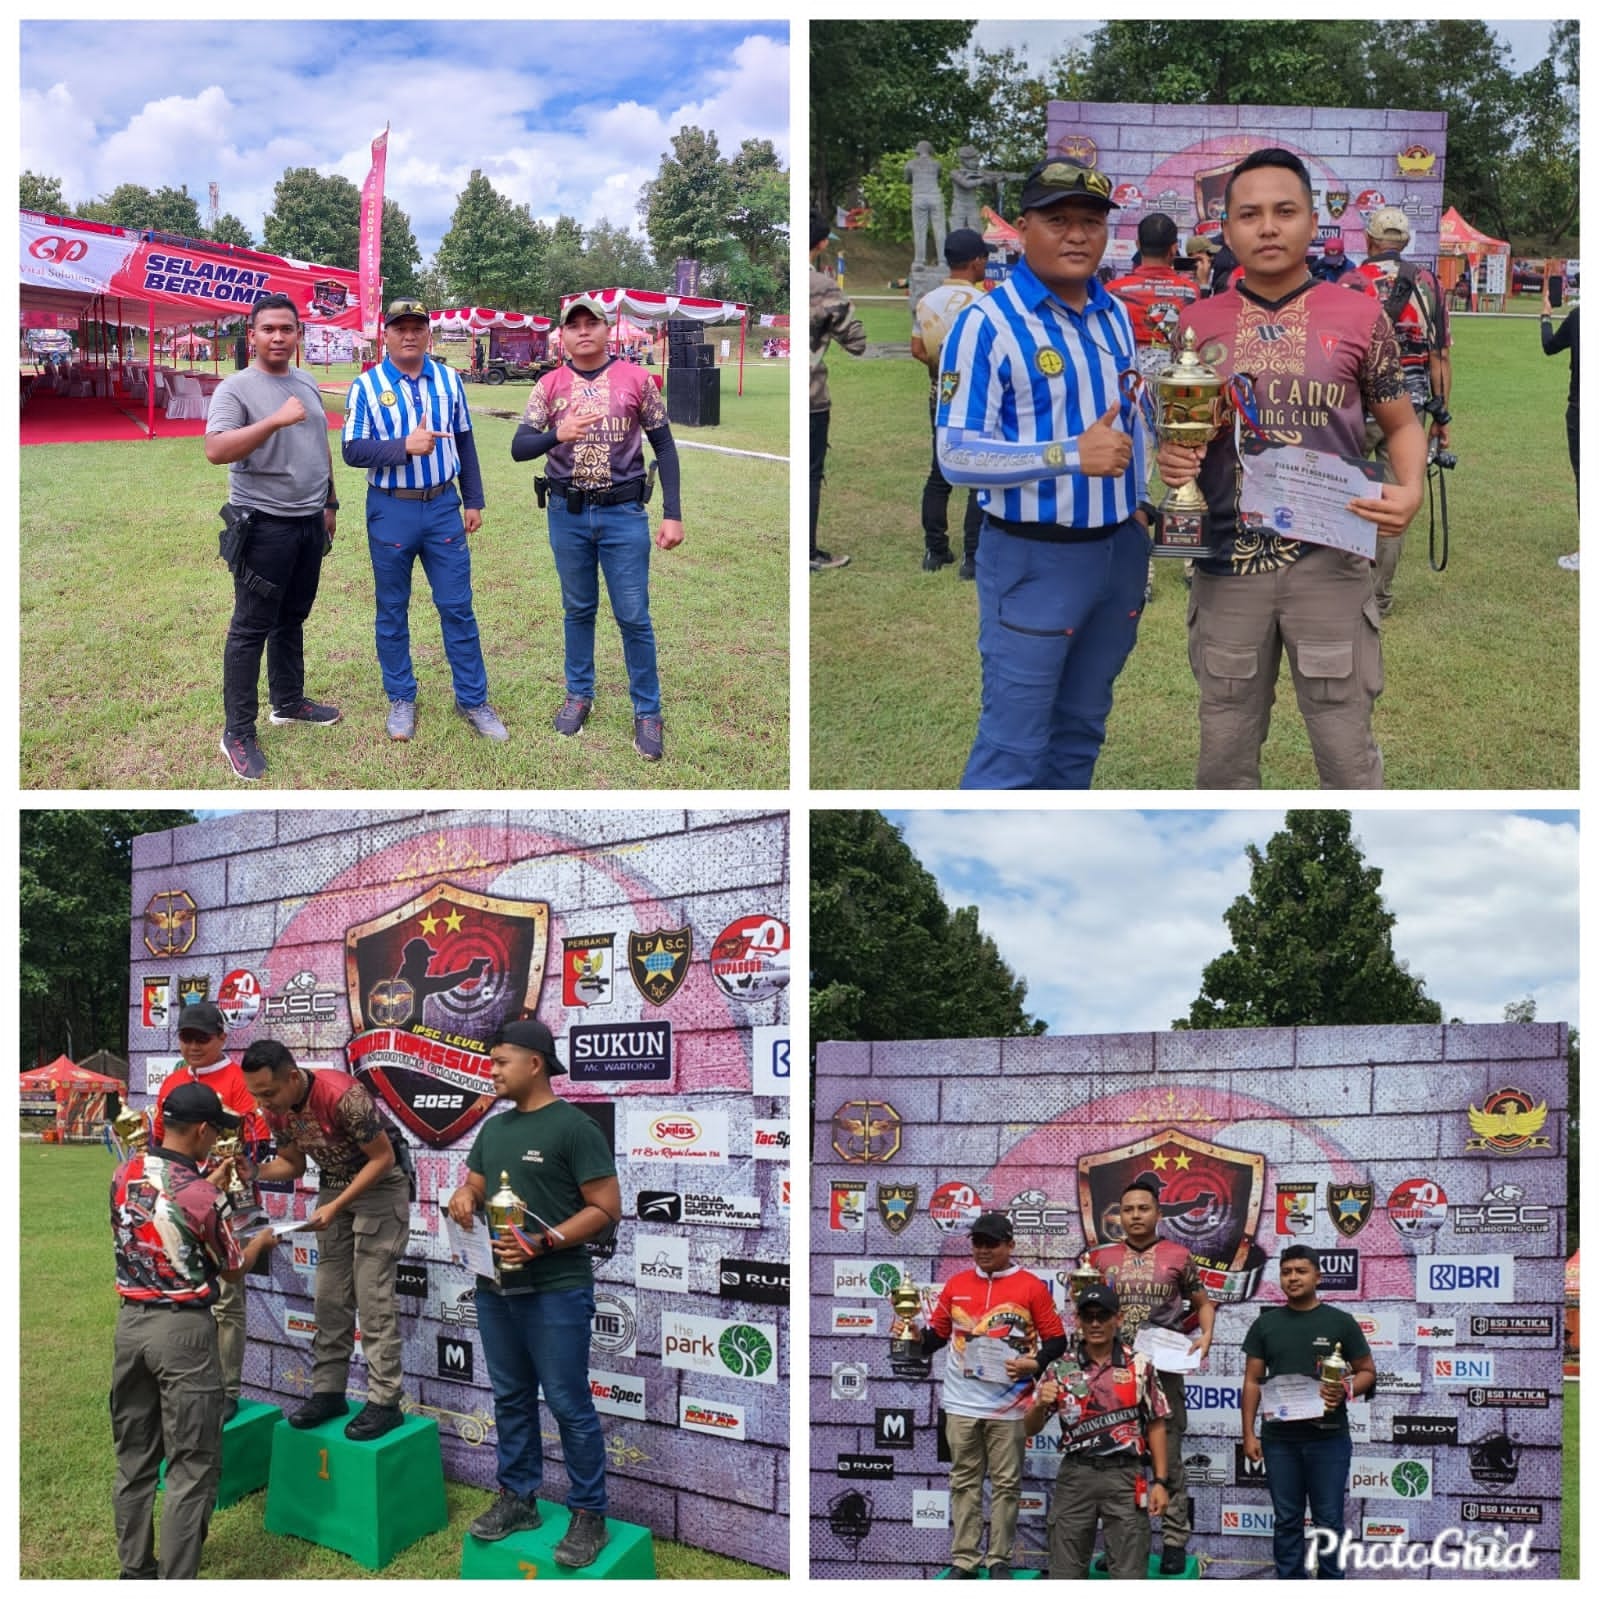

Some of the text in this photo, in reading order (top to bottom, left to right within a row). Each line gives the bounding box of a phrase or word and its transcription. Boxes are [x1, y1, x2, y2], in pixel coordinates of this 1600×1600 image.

[1318, 228, 1339, 240] KUN
[145, 253, 270, 288] SELAMAT
[1291, 410, 1330, 427] CLUB
[567, 936, 611, 949] PERBAKIN
[265, 993, 337, 1015] KSC
[412, 1024, 486, 1053] IPSC LEVEL
[575, 1030, 665, 1058] SUKUN
[603, 1061, 656, 1072] WARTONO
[413, 1094, 465, 1109] 2022
[754, 1129, 791, 1149] TacSp
[685, 1194, 724, 1203] RADJA
[685, 1202, 734, 1210] CUSTOM
[685, 1208, 761, 1219] SPORT WEAR
[1455, 1206, 1549, 1225] KSC
[1318, 1255, 1354, 1273] KUN
[836, 1272, 868, 1288] park
[1458, 1266, 1500, 1289] BRI
[673, 1323, 694, 1336] the
[1510, 1319, 1550, 1327] TACTICAL
[1417, 1325, 1455, 1338] TacSpec
[665, 1334, 715, 1358] park
[445, 1343, 465, 1369] M
[1455, 1360, 1490, 1377] BNI
[590, 1381, 643, 1404] TacSpec
[1507, 1391, 1546, 1399] TACTICAL
[883, 1414, 905, 1439] M
[1411, 1424, 1457, 1433] RUDY
[852, 1462, 893, 1471] RUDY
[1352, 1471, 1389, 1489] park
[1500, 1506, 1539, 1515] TACTICAL
